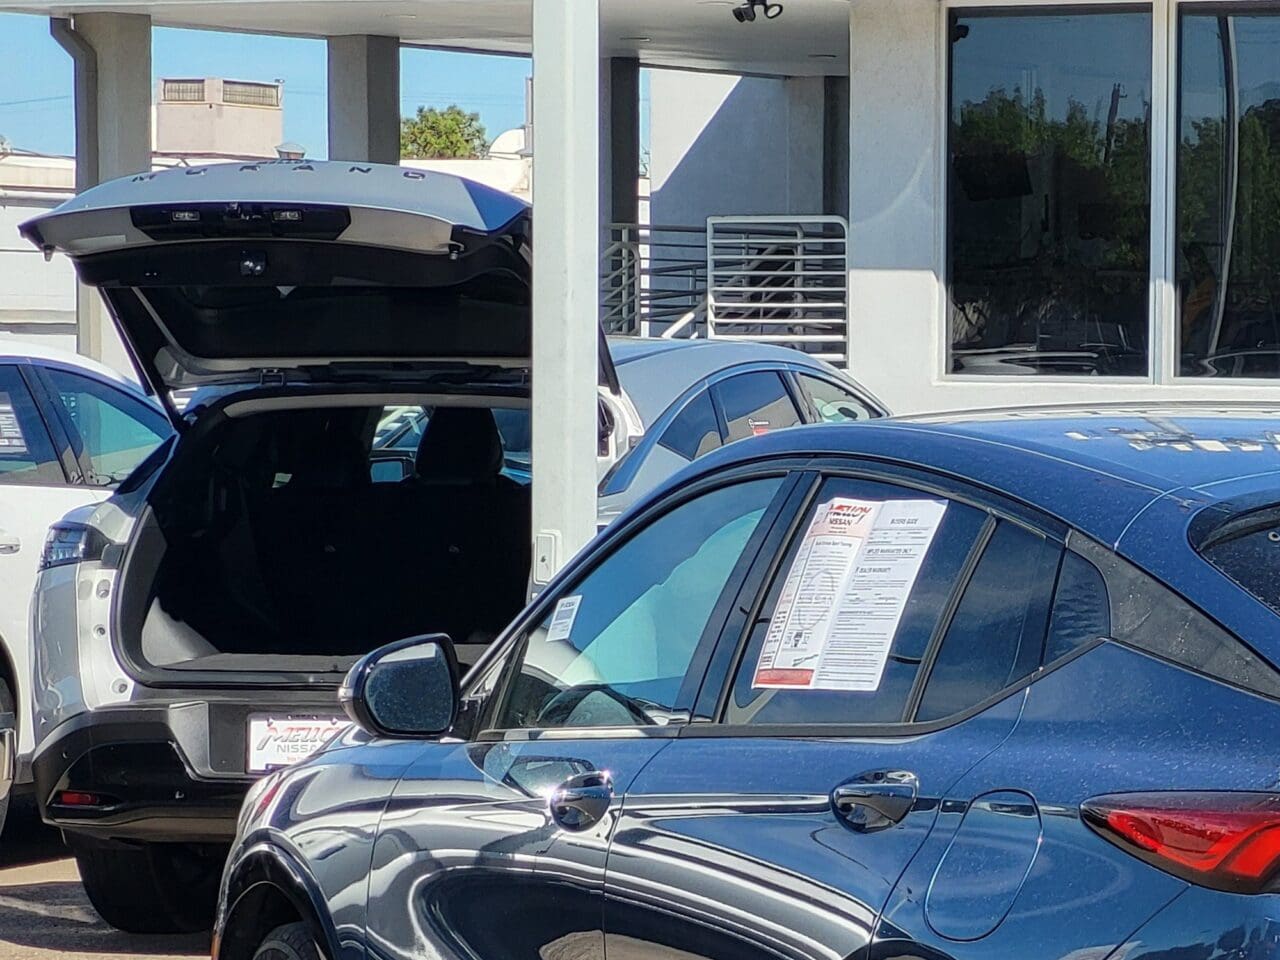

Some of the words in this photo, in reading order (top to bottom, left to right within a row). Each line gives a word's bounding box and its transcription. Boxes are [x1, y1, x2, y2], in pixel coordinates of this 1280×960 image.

[132, 164, 426, 182] MURANO
[256, 726, 343, 751] MELLO
[276, 743, 319, 753] NISSA
